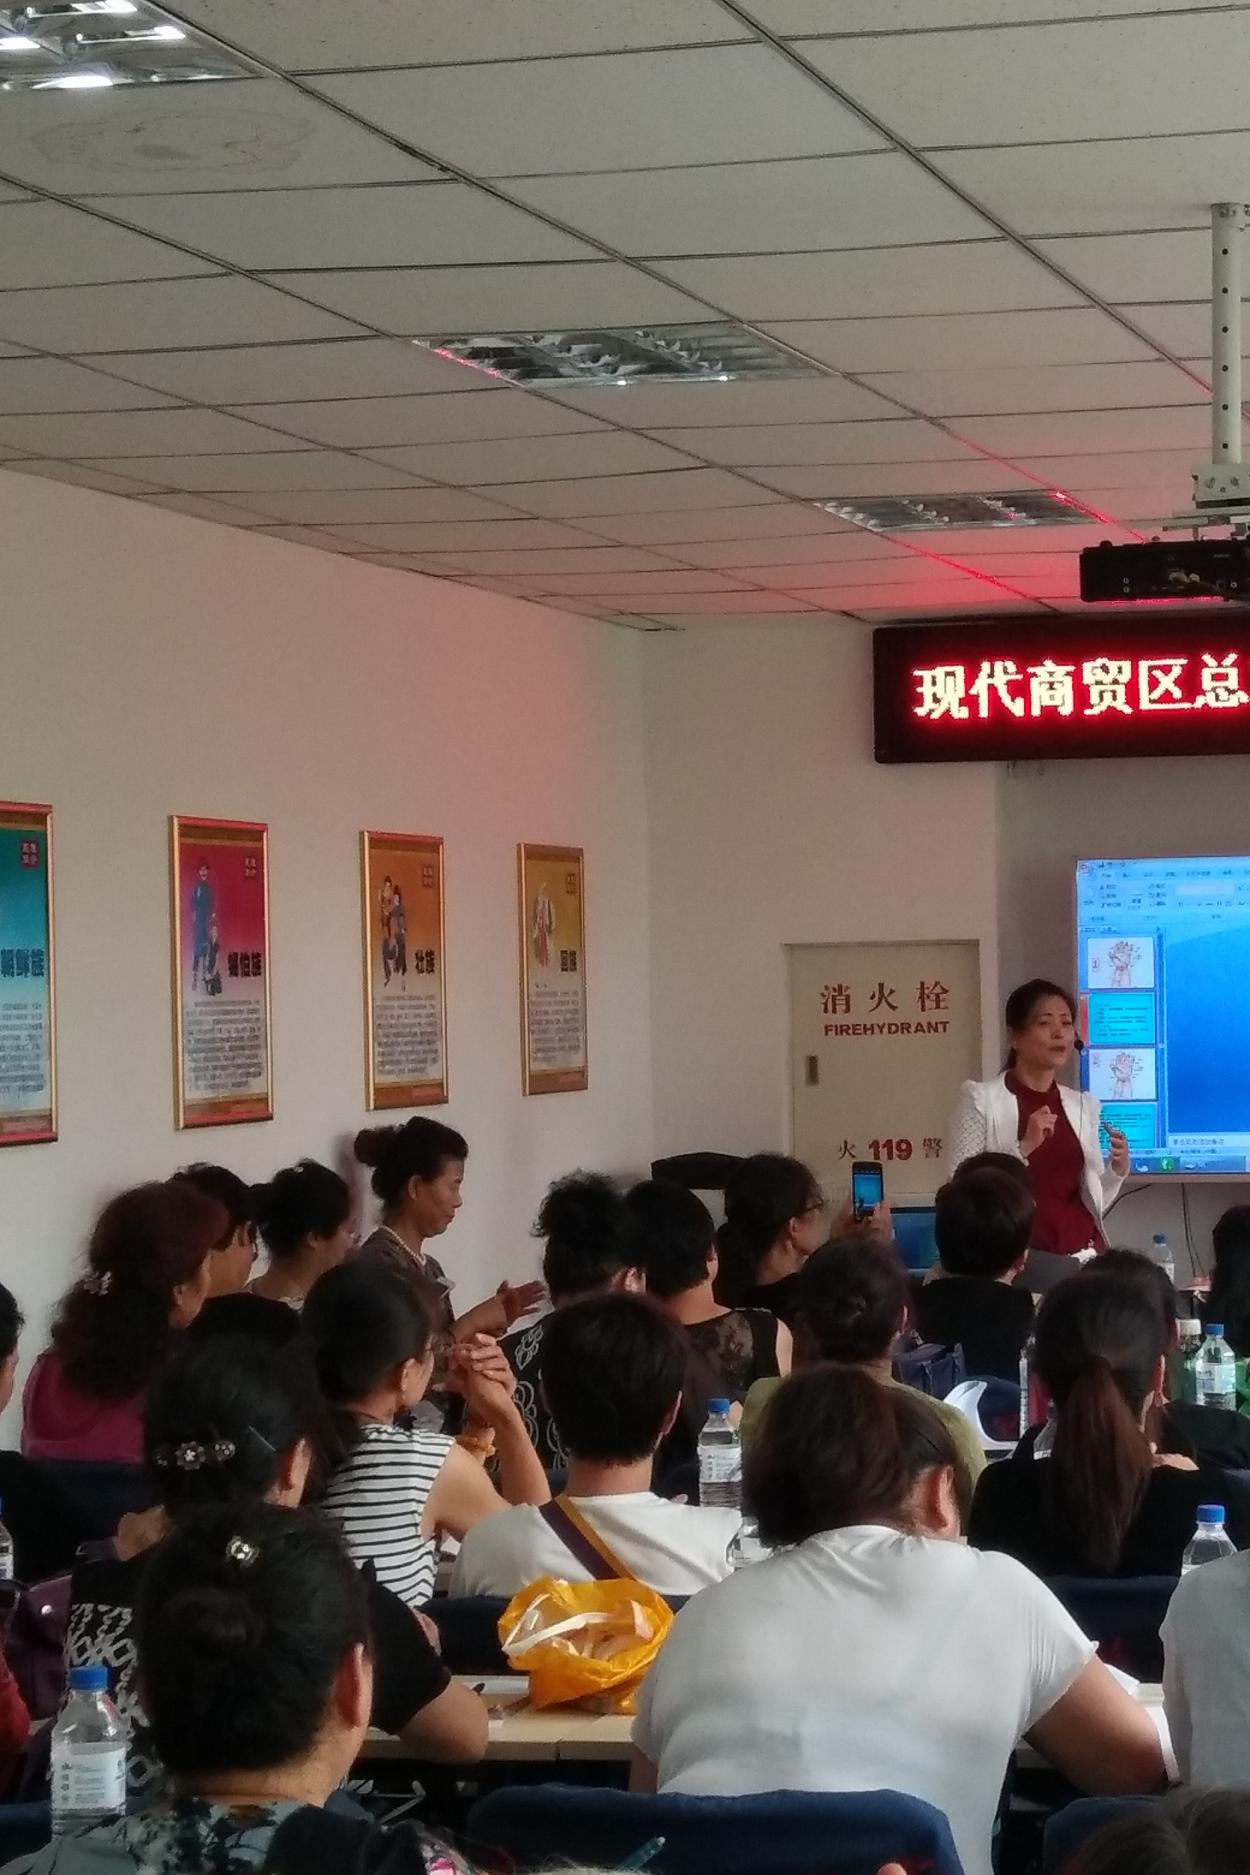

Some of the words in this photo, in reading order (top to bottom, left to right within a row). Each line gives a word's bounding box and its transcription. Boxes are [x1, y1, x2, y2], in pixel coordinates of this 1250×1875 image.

[820, 980, 949, 1014] 消火栓
[824, 1021, 950, 1037] FIREHYDRANT
[838, 1140, 856, 1161] 火
[868, 1139, 913, 1161] 119
